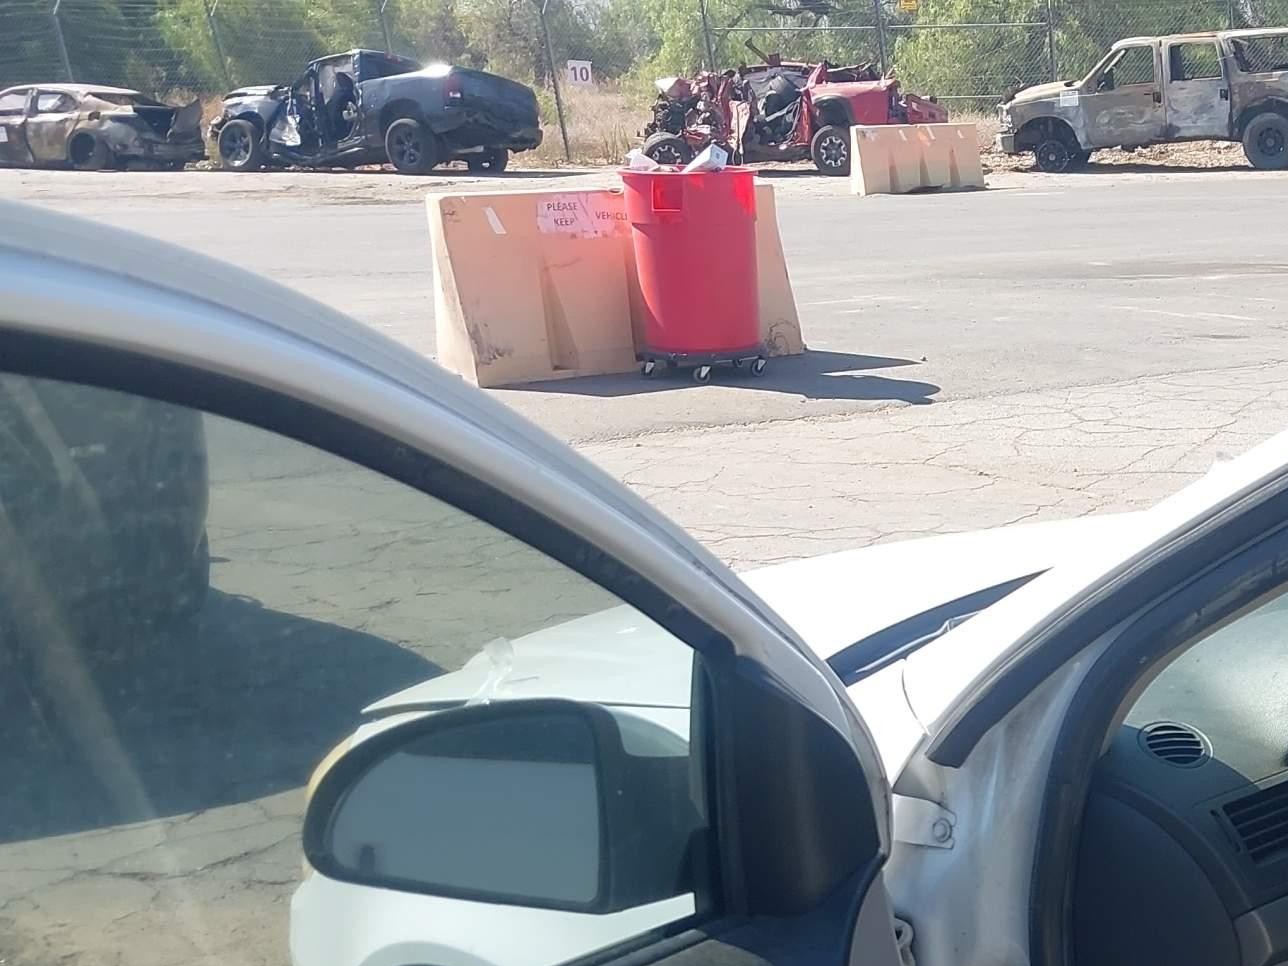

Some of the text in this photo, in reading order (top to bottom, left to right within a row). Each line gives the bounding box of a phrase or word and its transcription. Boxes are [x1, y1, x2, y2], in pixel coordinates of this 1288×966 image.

[570, 66, 590, 82] 10
[546, 202, 578, 211] PLEASE
[553, 217, 575, 226] KEEP
